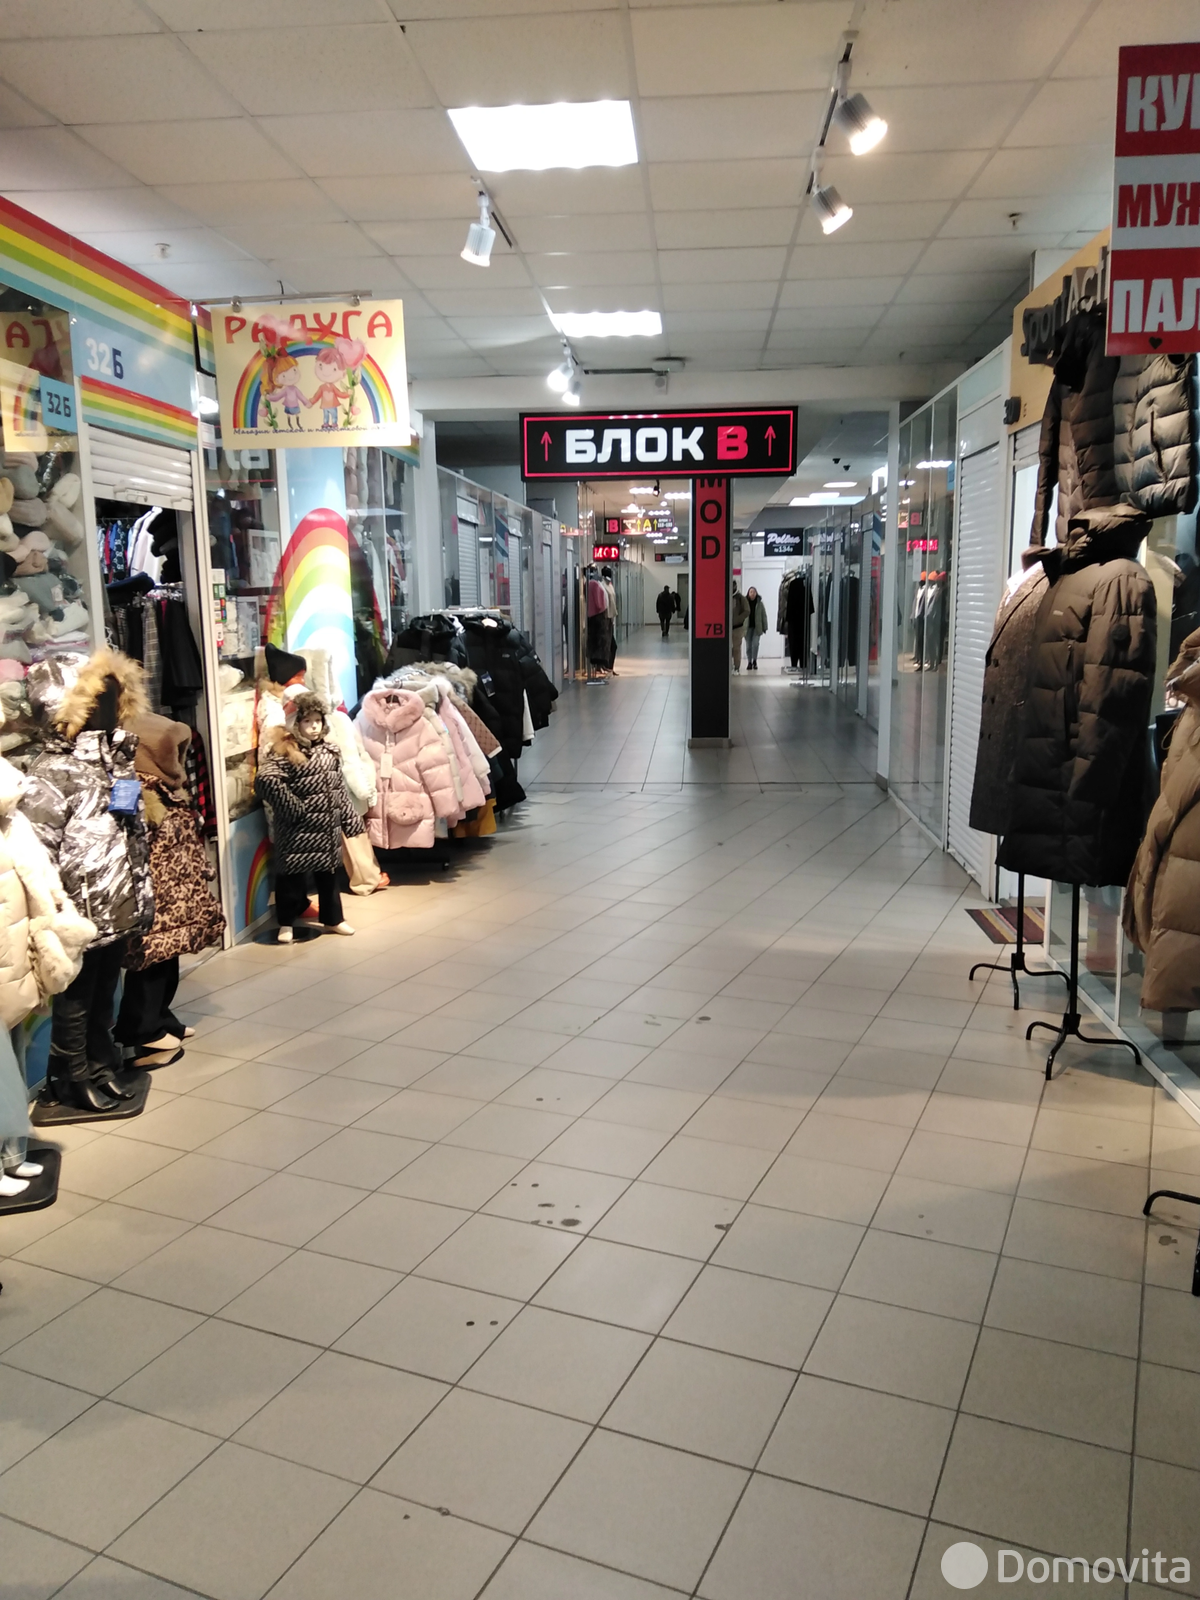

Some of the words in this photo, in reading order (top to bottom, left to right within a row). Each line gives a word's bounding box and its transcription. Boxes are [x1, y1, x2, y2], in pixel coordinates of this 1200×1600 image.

[224, 309, 393, 346] РАДУГА
[86, 337, 124, 380] 32Б
[565, 427, 704, 463] БЛОК
[717, 426, 749, 461] В
